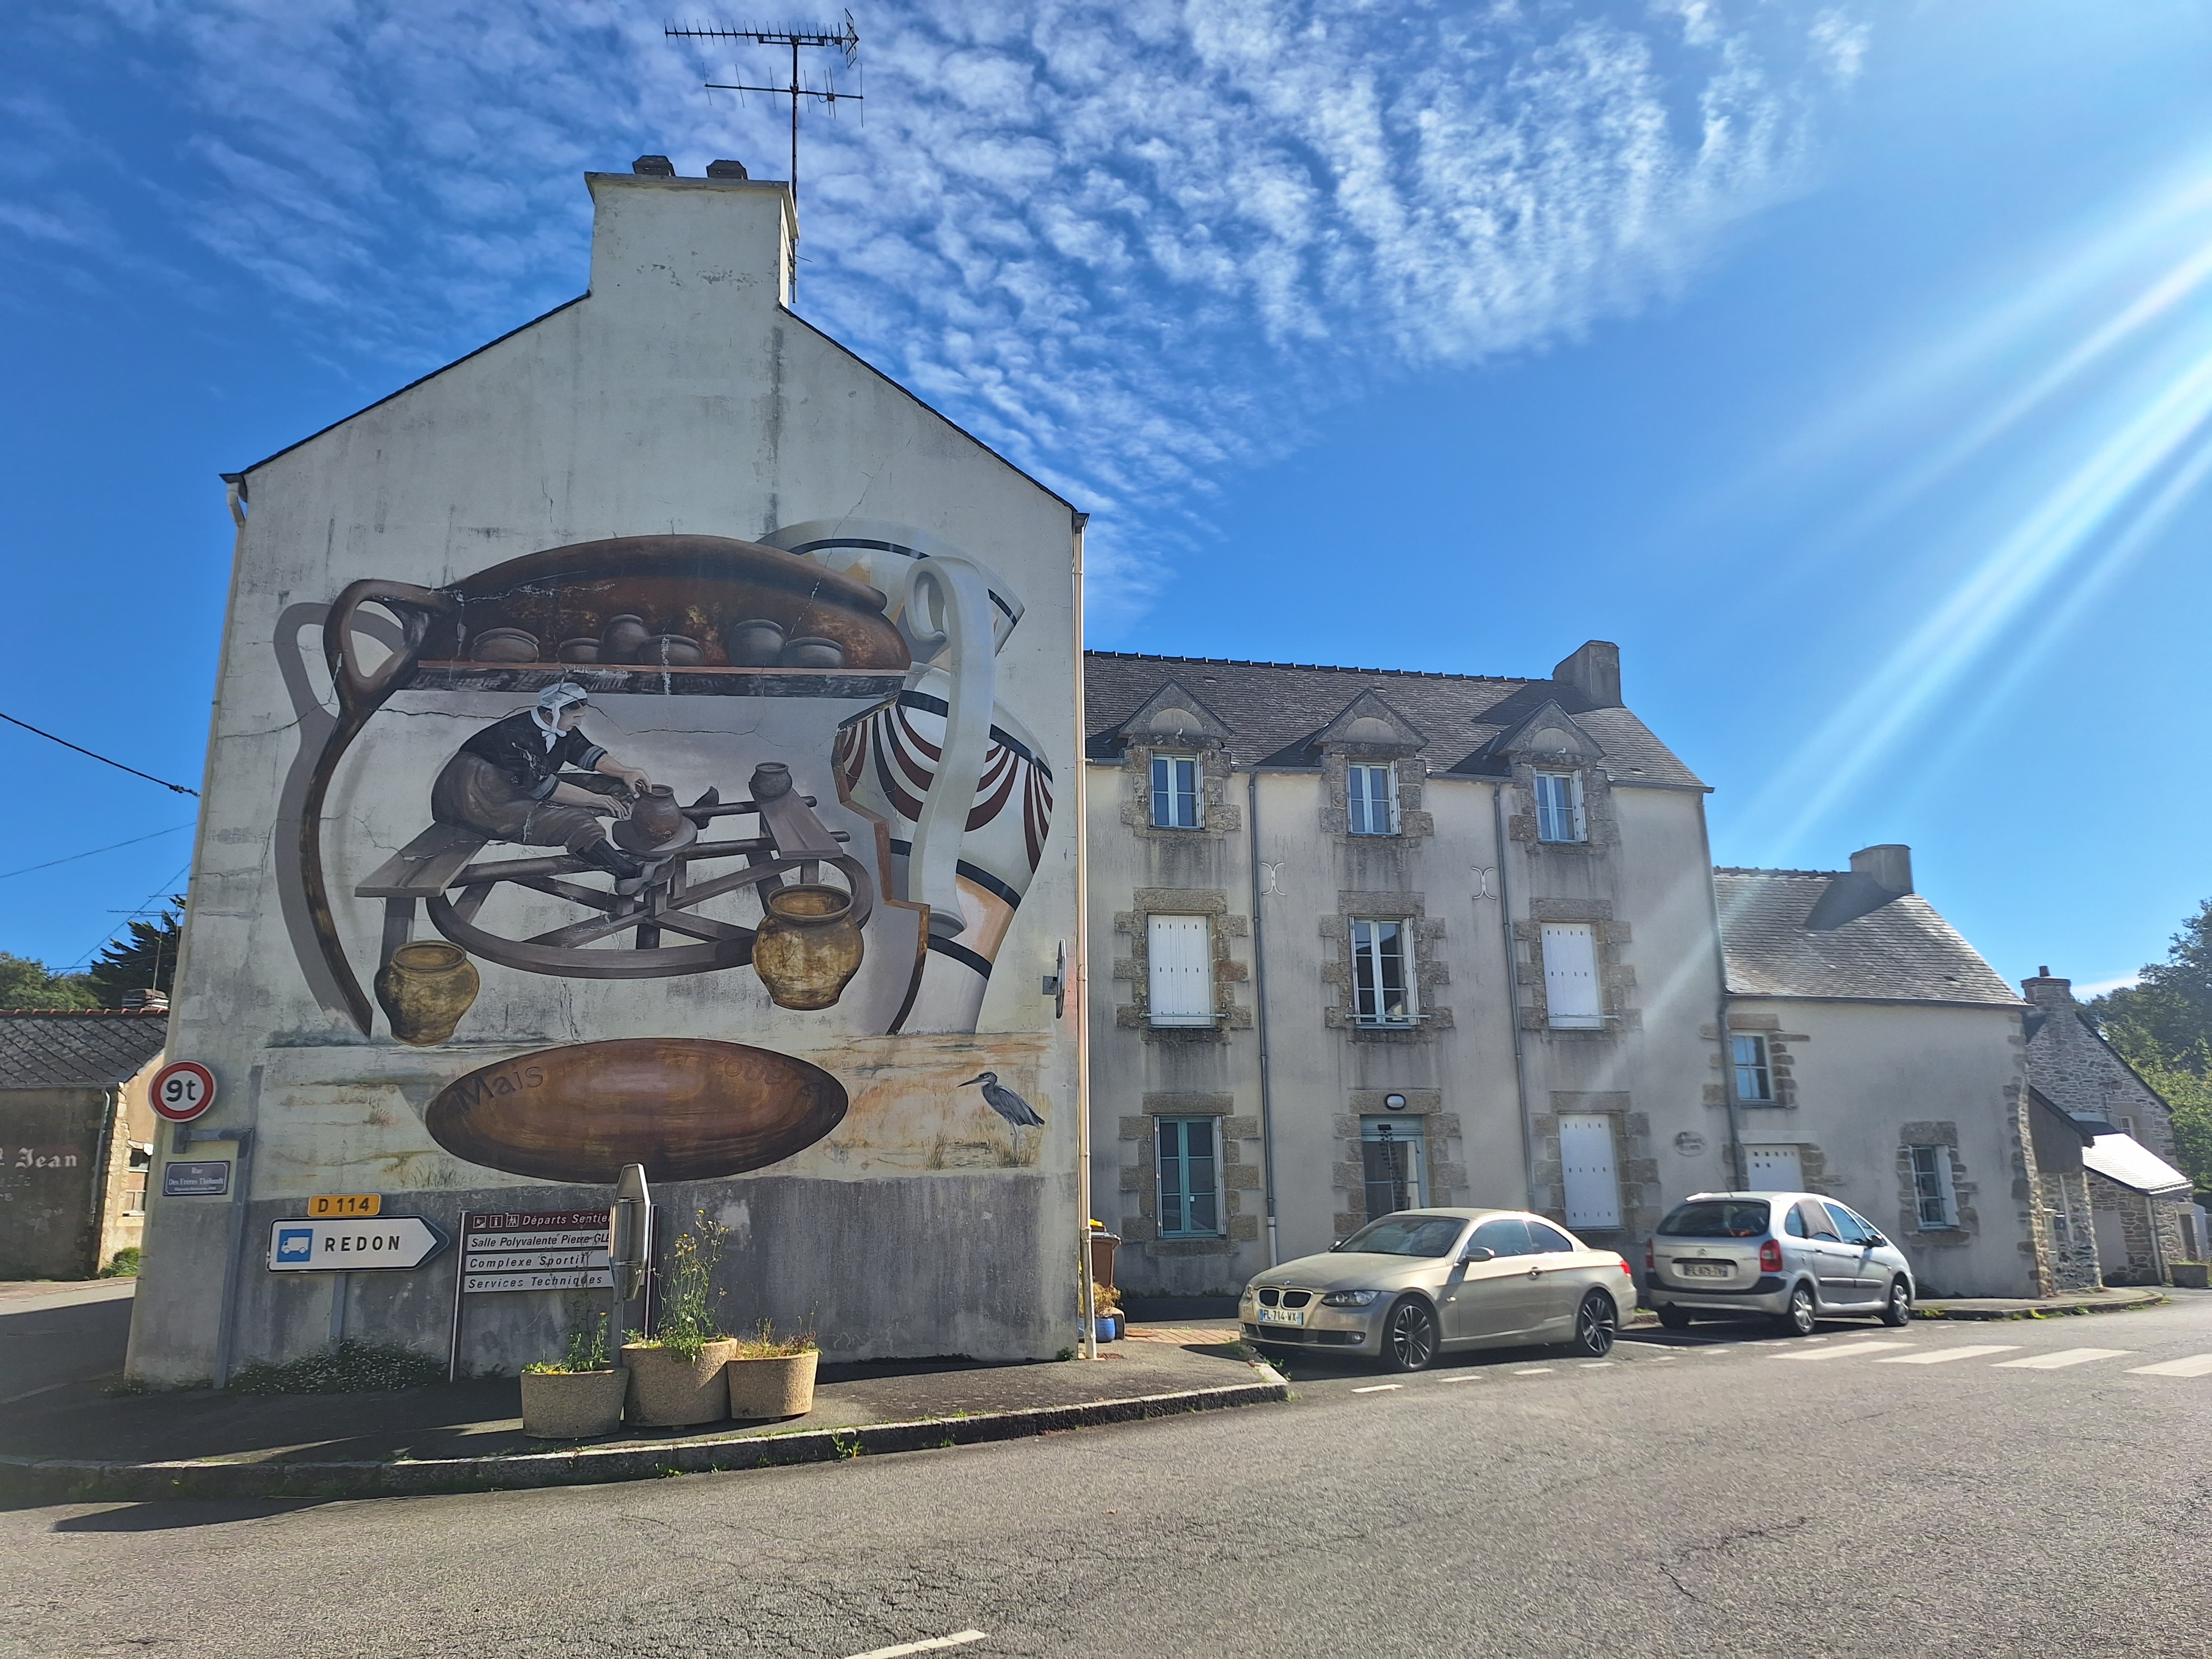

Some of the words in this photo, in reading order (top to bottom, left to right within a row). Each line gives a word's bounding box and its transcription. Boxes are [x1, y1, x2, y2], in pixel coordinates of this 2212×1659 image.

[165, 1079, 197, 1102] 9t
[15, 1147, 78, 1169] Jean
[318, 1199, 329, 1212] D
[337, 1198, 370, 1212] 114
[522, 1214, 567, 1227] Départs
[325, 1236, 401, 1252] REDON
[472, 1238, 496, 1248] Salle
[500, 1236, 557, 1248] Polyvalente
[561, 1234, 589, 1244] Pierre
[470, 1258, 532, 1270] Complexe
[539, 1255, 586, 1267] Sportif
[468, 1277, 523, 1289] Services
[531, 1275, 602, 1287] Techniques
